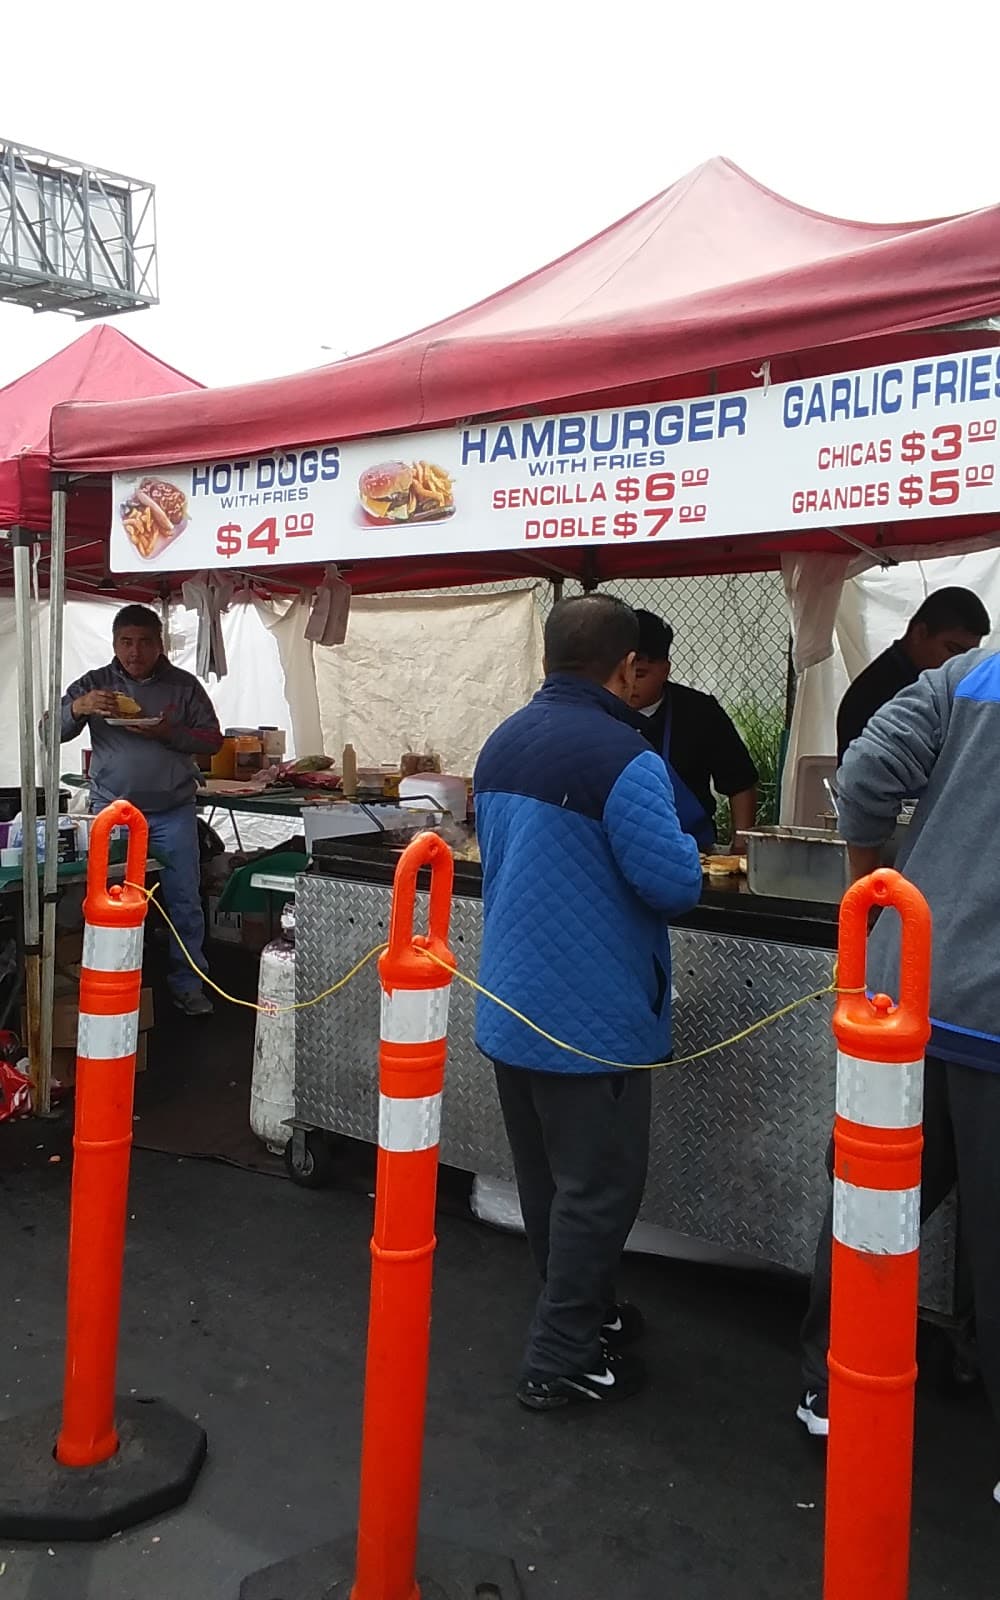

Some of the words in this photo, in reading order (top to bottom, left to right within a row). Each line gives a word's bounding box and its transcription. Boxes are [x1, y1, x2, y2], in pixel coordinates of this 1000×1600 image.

[783, 368, 904, 429] GARLIC
[911, 354, 1000, 410] FRIE
[461, 396, 748, 466] HAMBURGER
[528, 458, 587, 477] WITH
[593, 450, 666, 471] FRIES
[818, 439, 892, 470] CHICAS
[191, 462, 251, 497] HOT
[256, 447, 341, 488] DOGS
[220, 494, 260, 510] WITH
[263, 487, 309, 504] FRIES
[492, 482, 607, 510] SENCILLA
[792, 482, 890, 514] GRANDES
[525, 516, 607, 540] DOBLE
